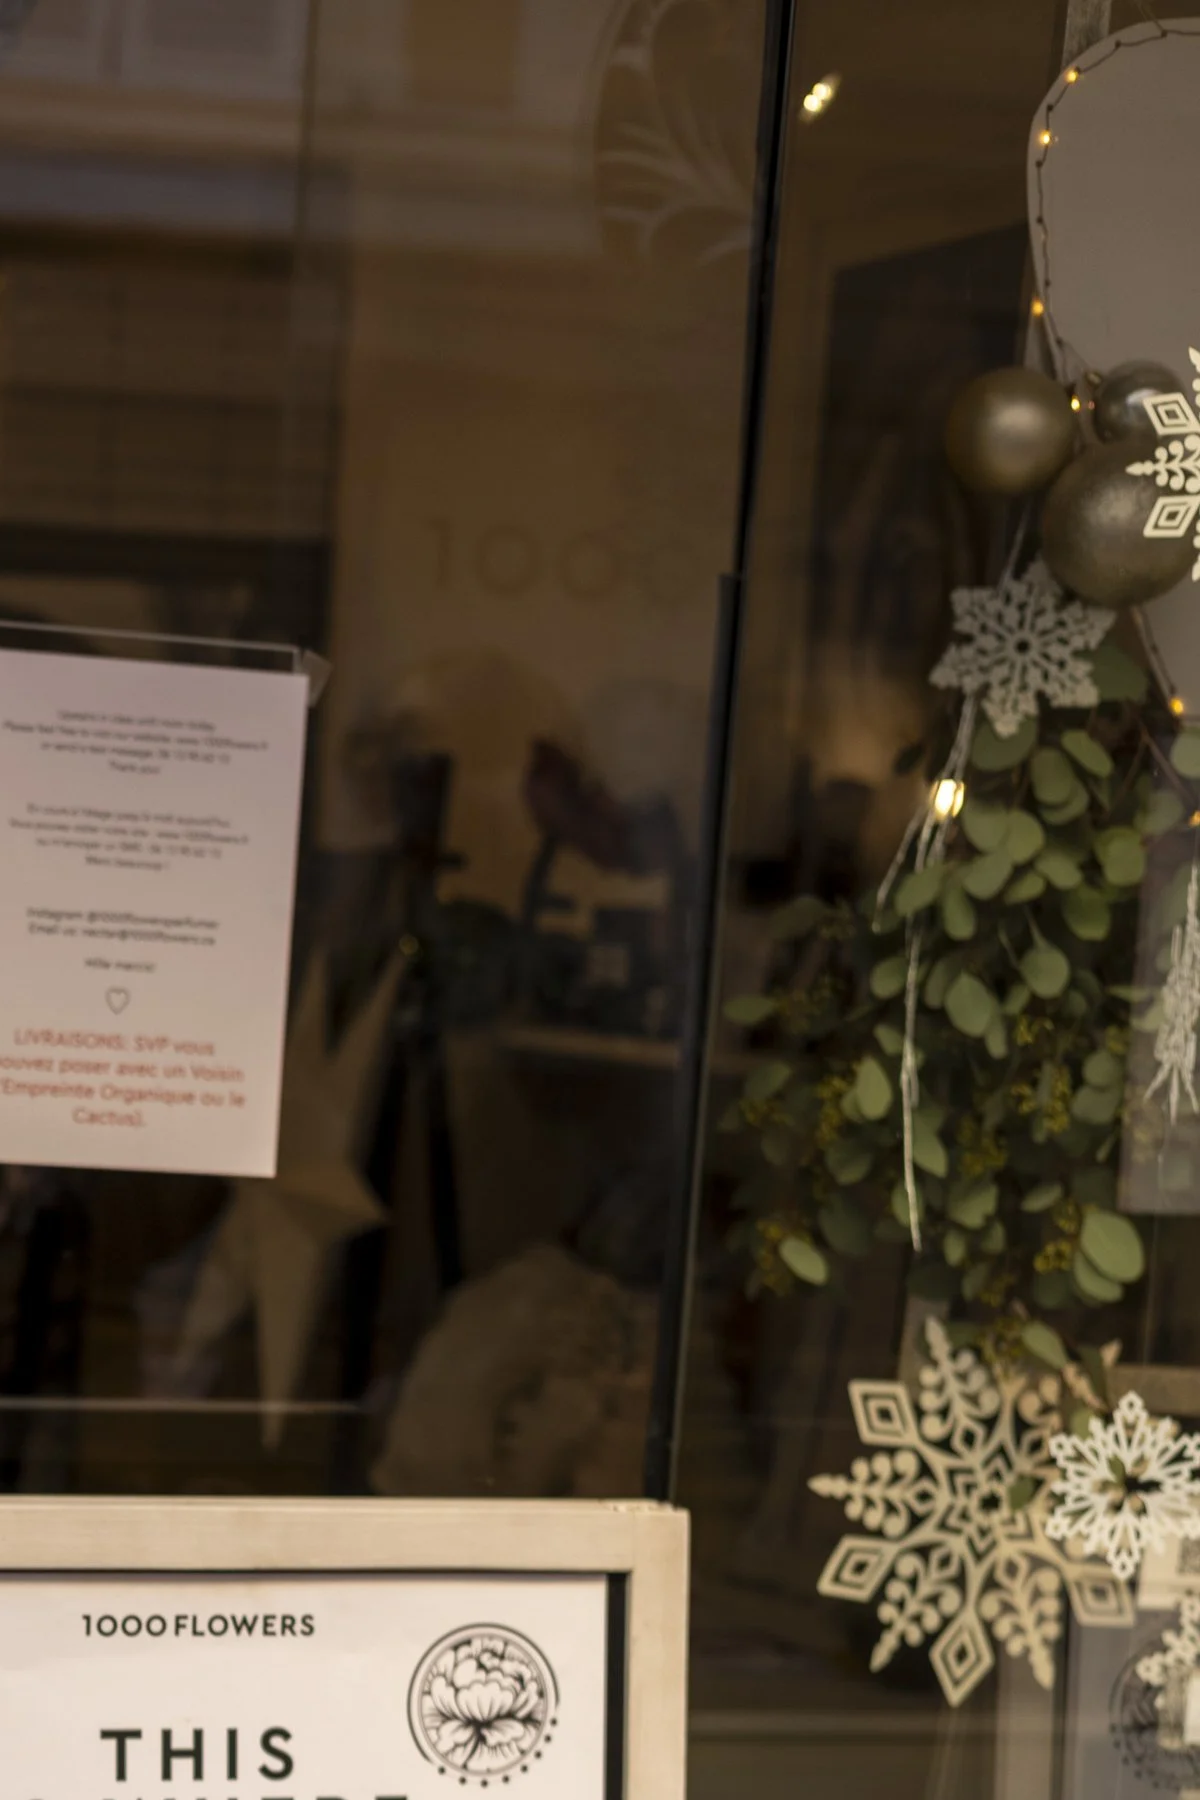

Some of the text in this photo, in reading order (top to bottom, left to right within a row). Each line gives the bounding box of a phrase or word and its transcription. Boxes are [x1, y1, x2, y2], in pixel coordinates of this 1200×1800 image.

[82, 1614, 315, 1638] 1000 FLOWERS
[99, 1726, 294, 1782] THIS
